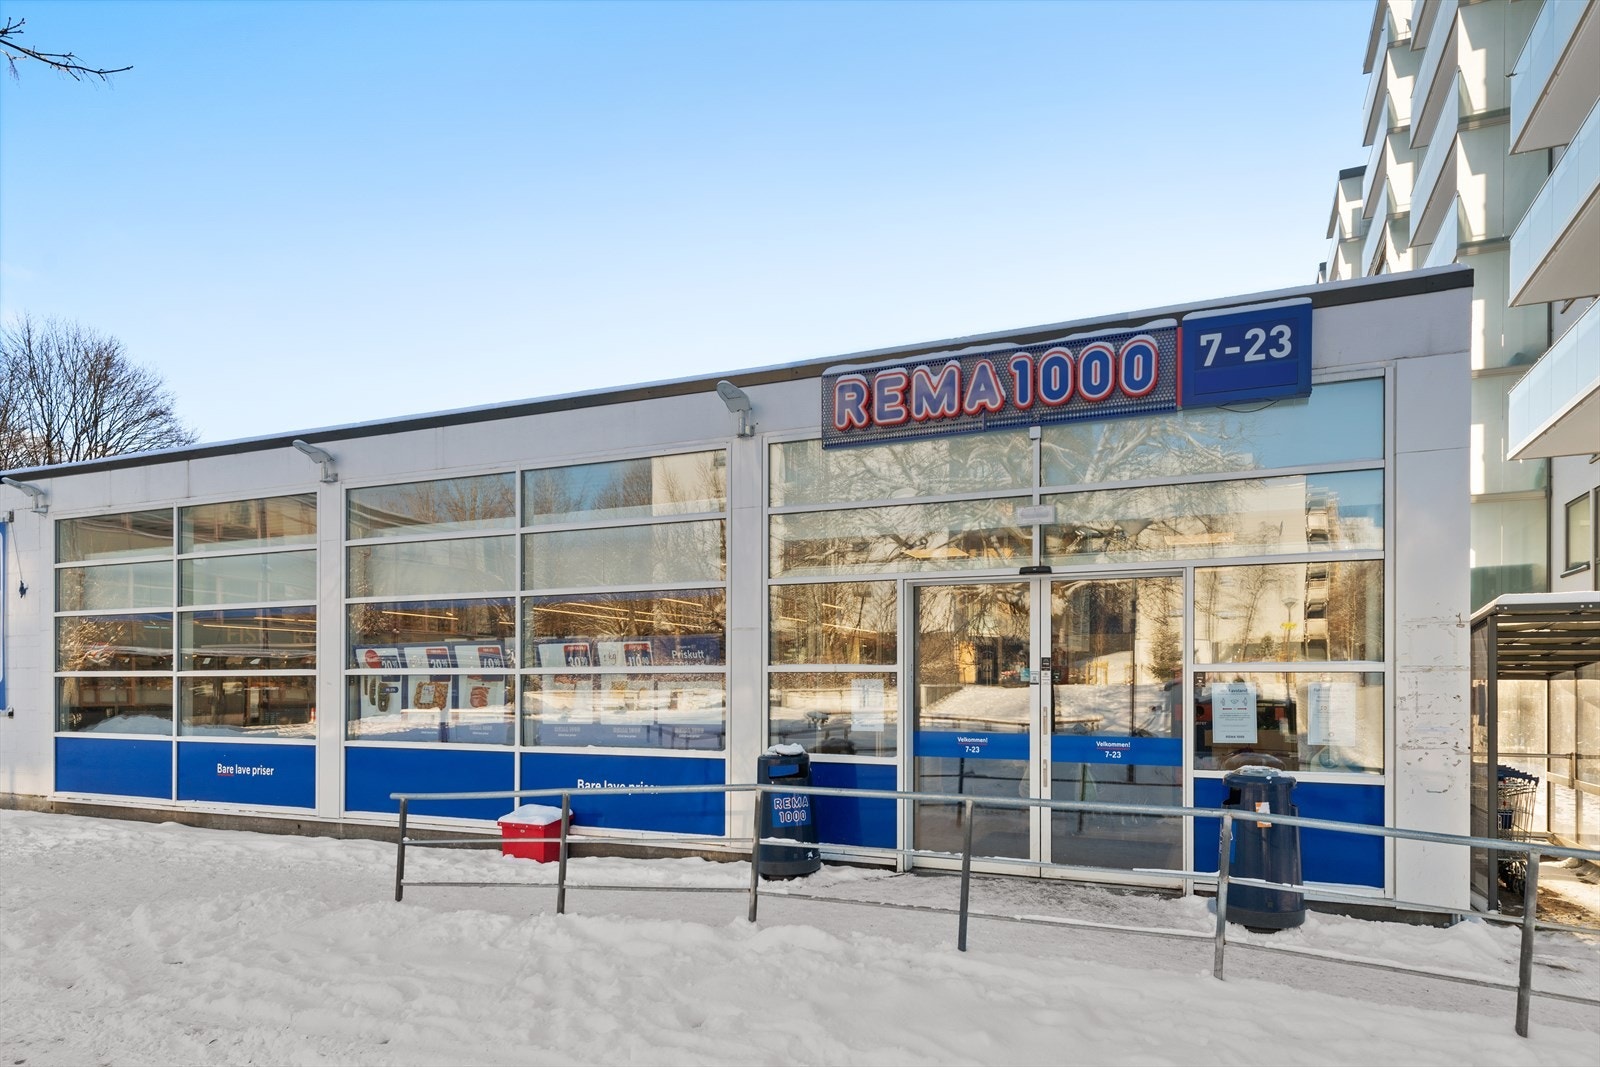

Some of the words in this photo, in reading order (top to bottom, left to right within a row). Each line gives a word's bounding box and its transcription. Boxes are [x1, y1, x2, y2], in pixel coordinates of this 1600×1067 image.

[1200, 324, 1293, 367] 7-23
[834, 360, 1004, 431] REMA
[1010, 336, 1159, 410] 1000
[671, 649, 705, 660] Priskutt
[957, 736, 988, 744] Velkommen!
[1105, 751, 1122, 759] 7-23
[217, 763, 234, 774] Bare
[235, 763, 251, 775] lave
[251, 765, 275, 777] priser
[773, 796, 809, 810] REMA
[779, 809, 807, 824] 1000
